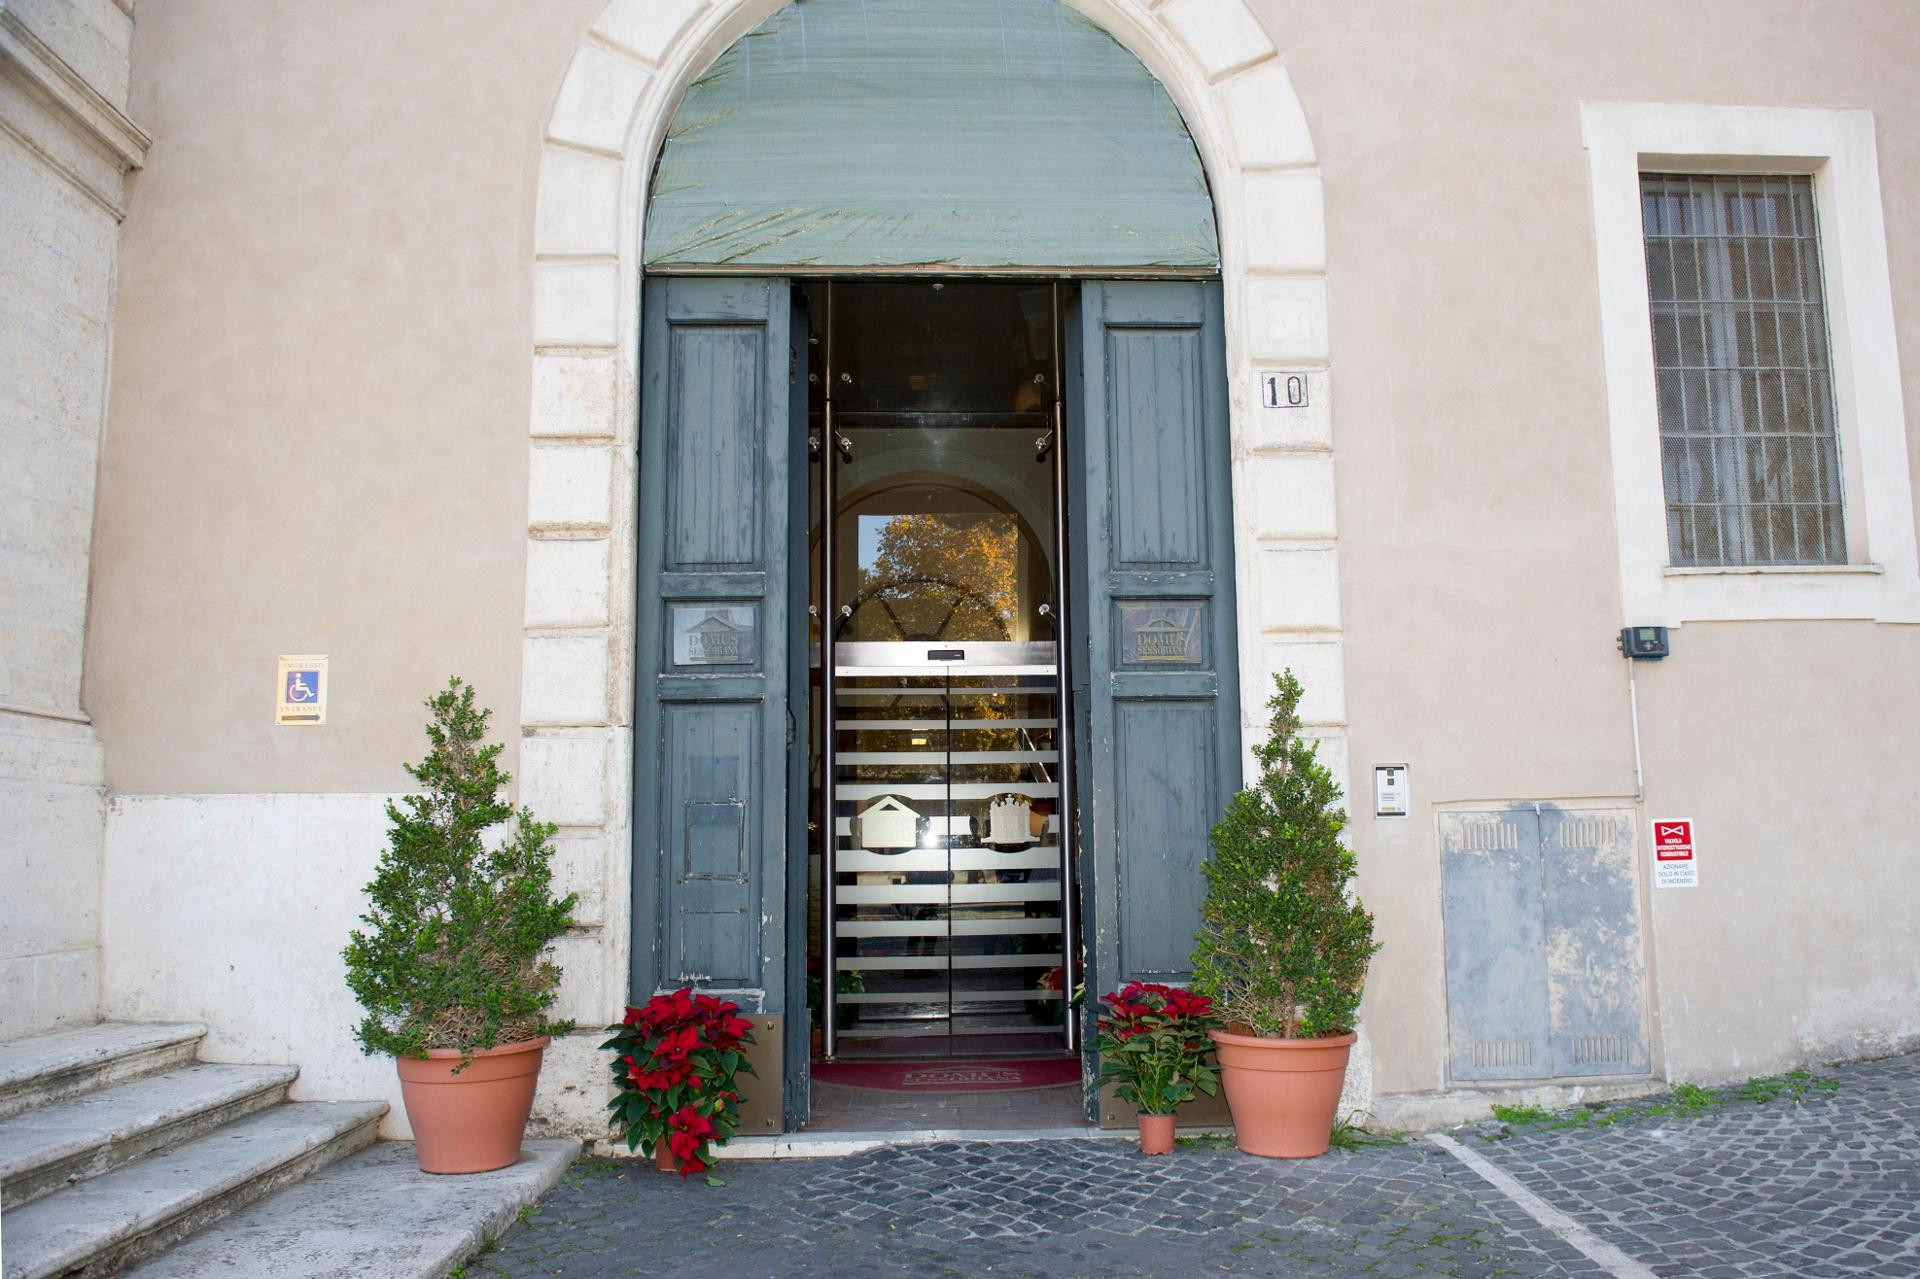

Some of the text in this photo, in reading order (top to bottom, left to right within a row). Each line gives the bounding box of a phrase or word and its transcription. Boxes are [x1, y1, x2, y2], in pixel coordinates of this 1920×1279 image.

[1267, 376, 1302, 406] 10
[688, 634, 738, 646] DOMUS
[1137, 633, 1187, 645] DOMUS
